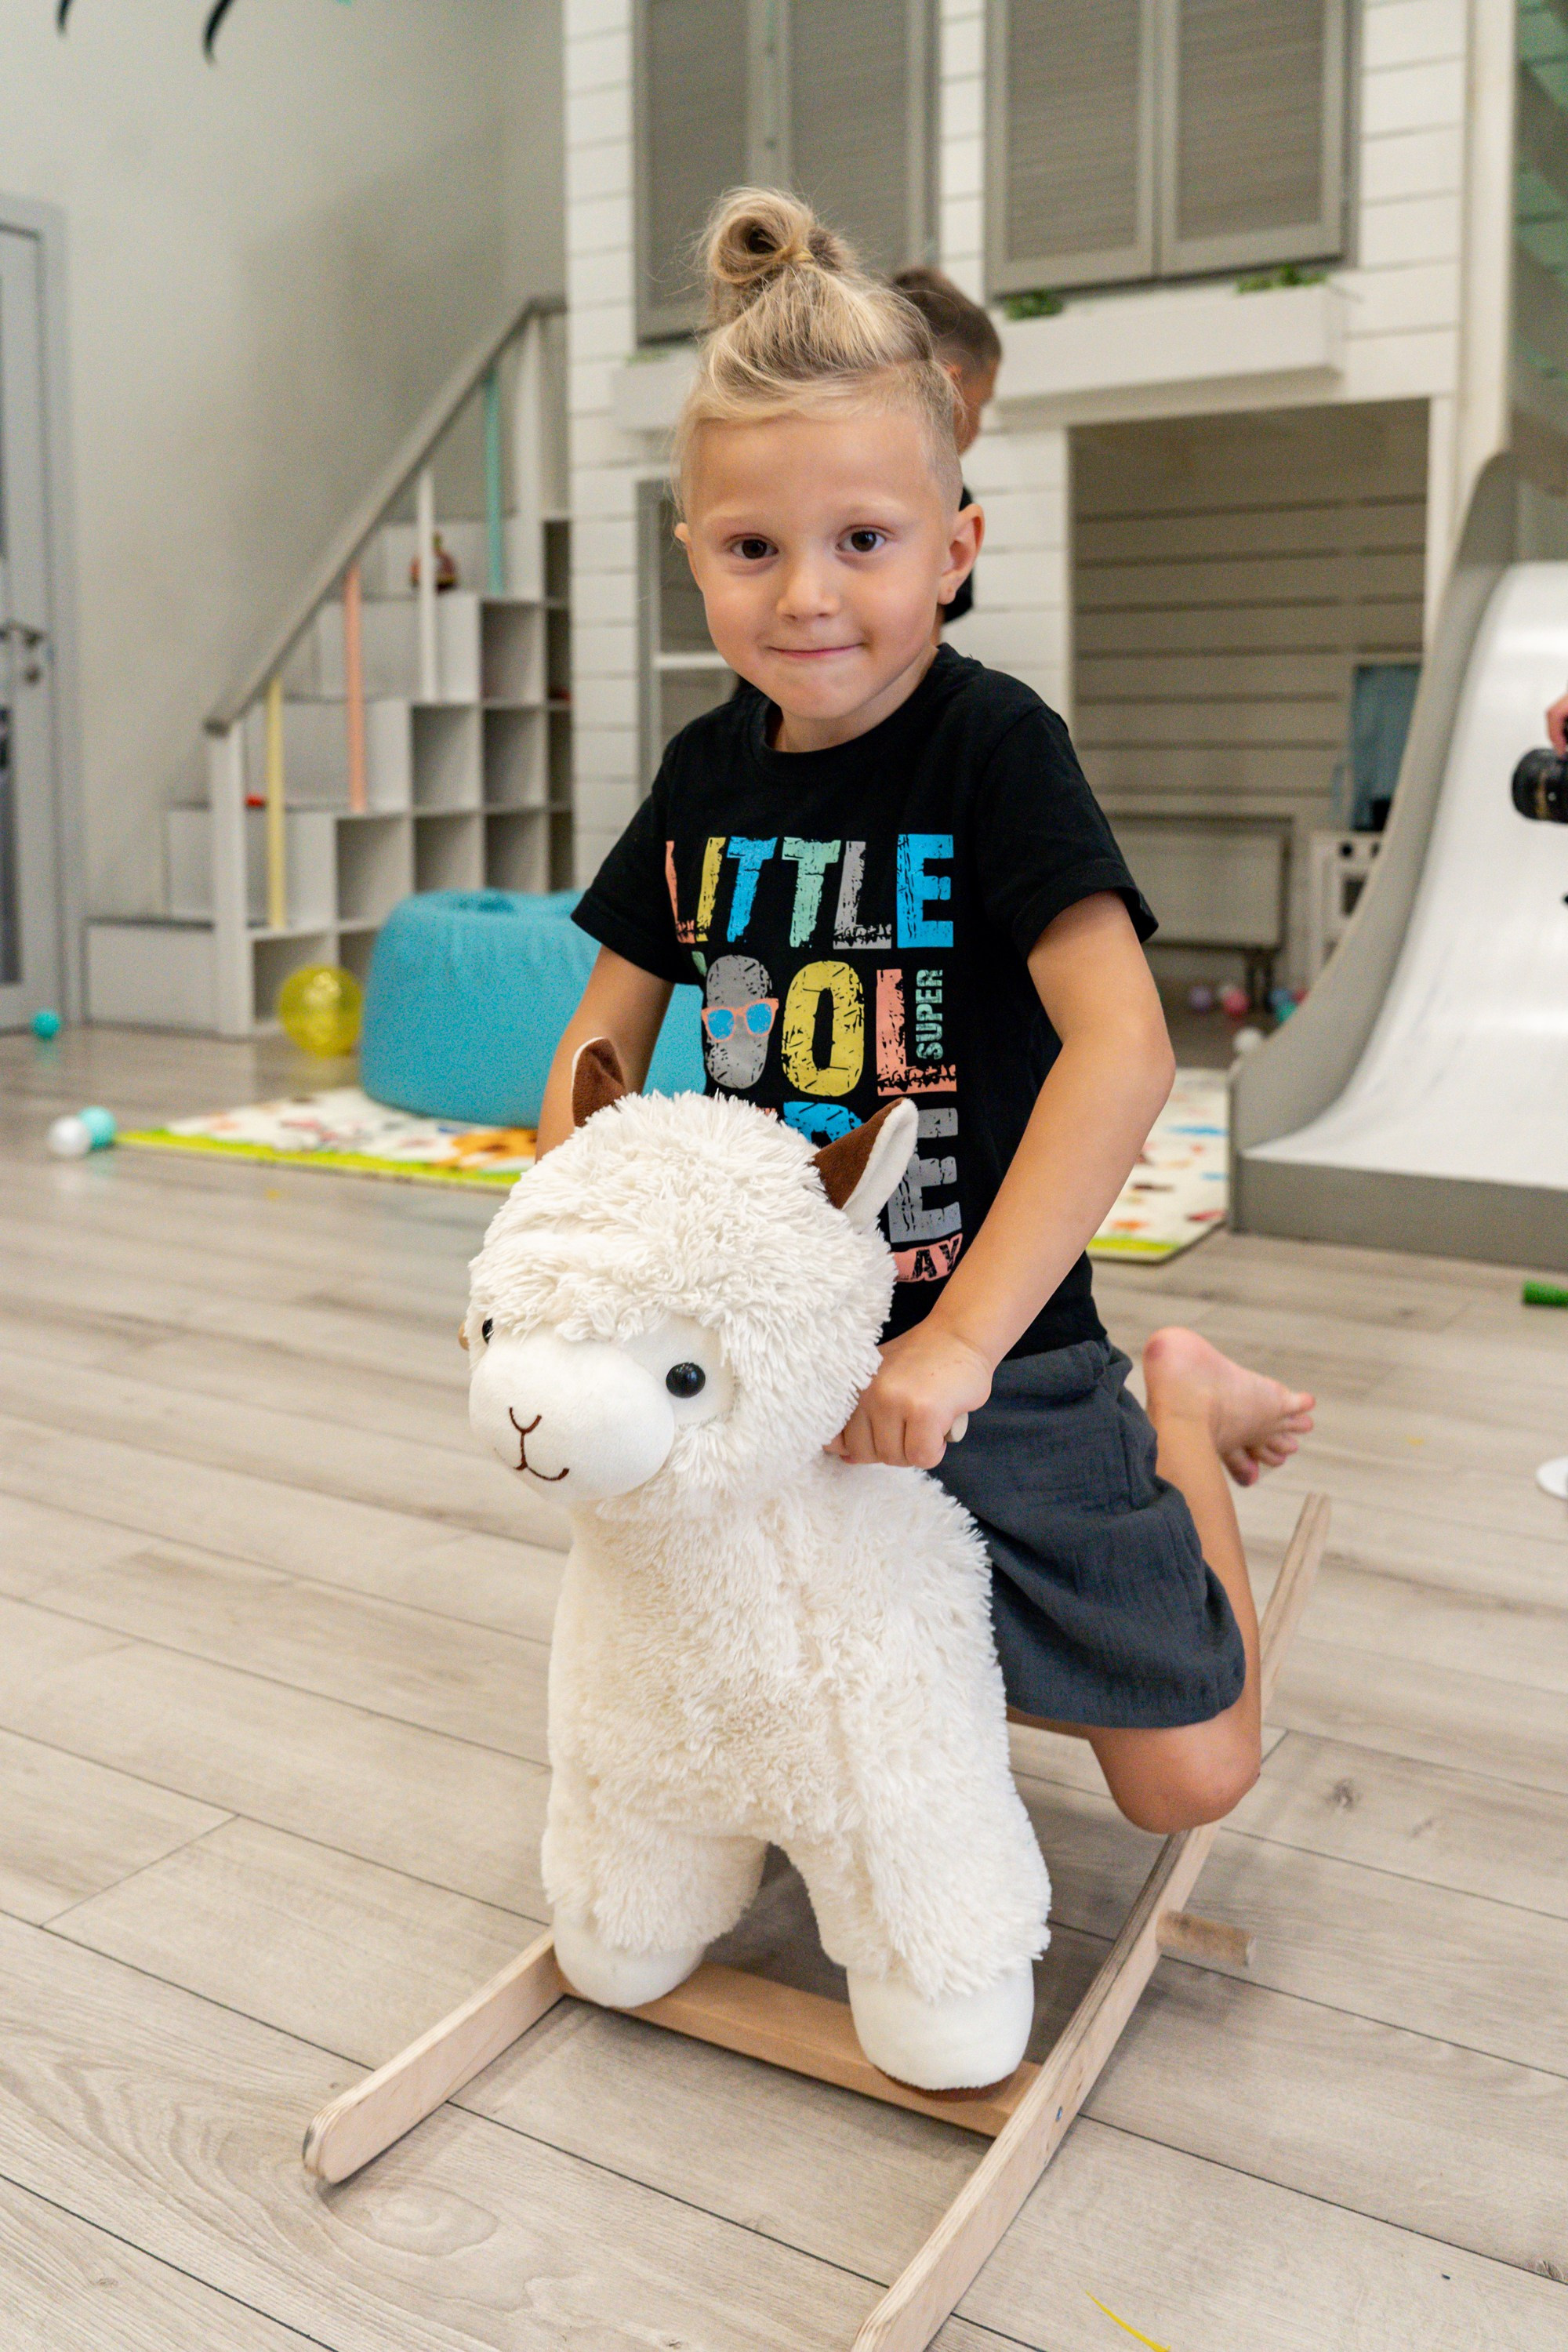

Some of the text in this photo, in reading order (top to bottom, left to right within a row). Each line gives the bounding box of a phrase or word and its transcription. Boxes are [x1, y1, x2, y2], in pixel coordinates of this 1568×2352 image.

[665, 833, 954, 949] LITTLE
[691, 950, 958, 1097] OOL
[916, 969, 943, 1059] SUPER
[895, 1238, 960, 1280] AY
